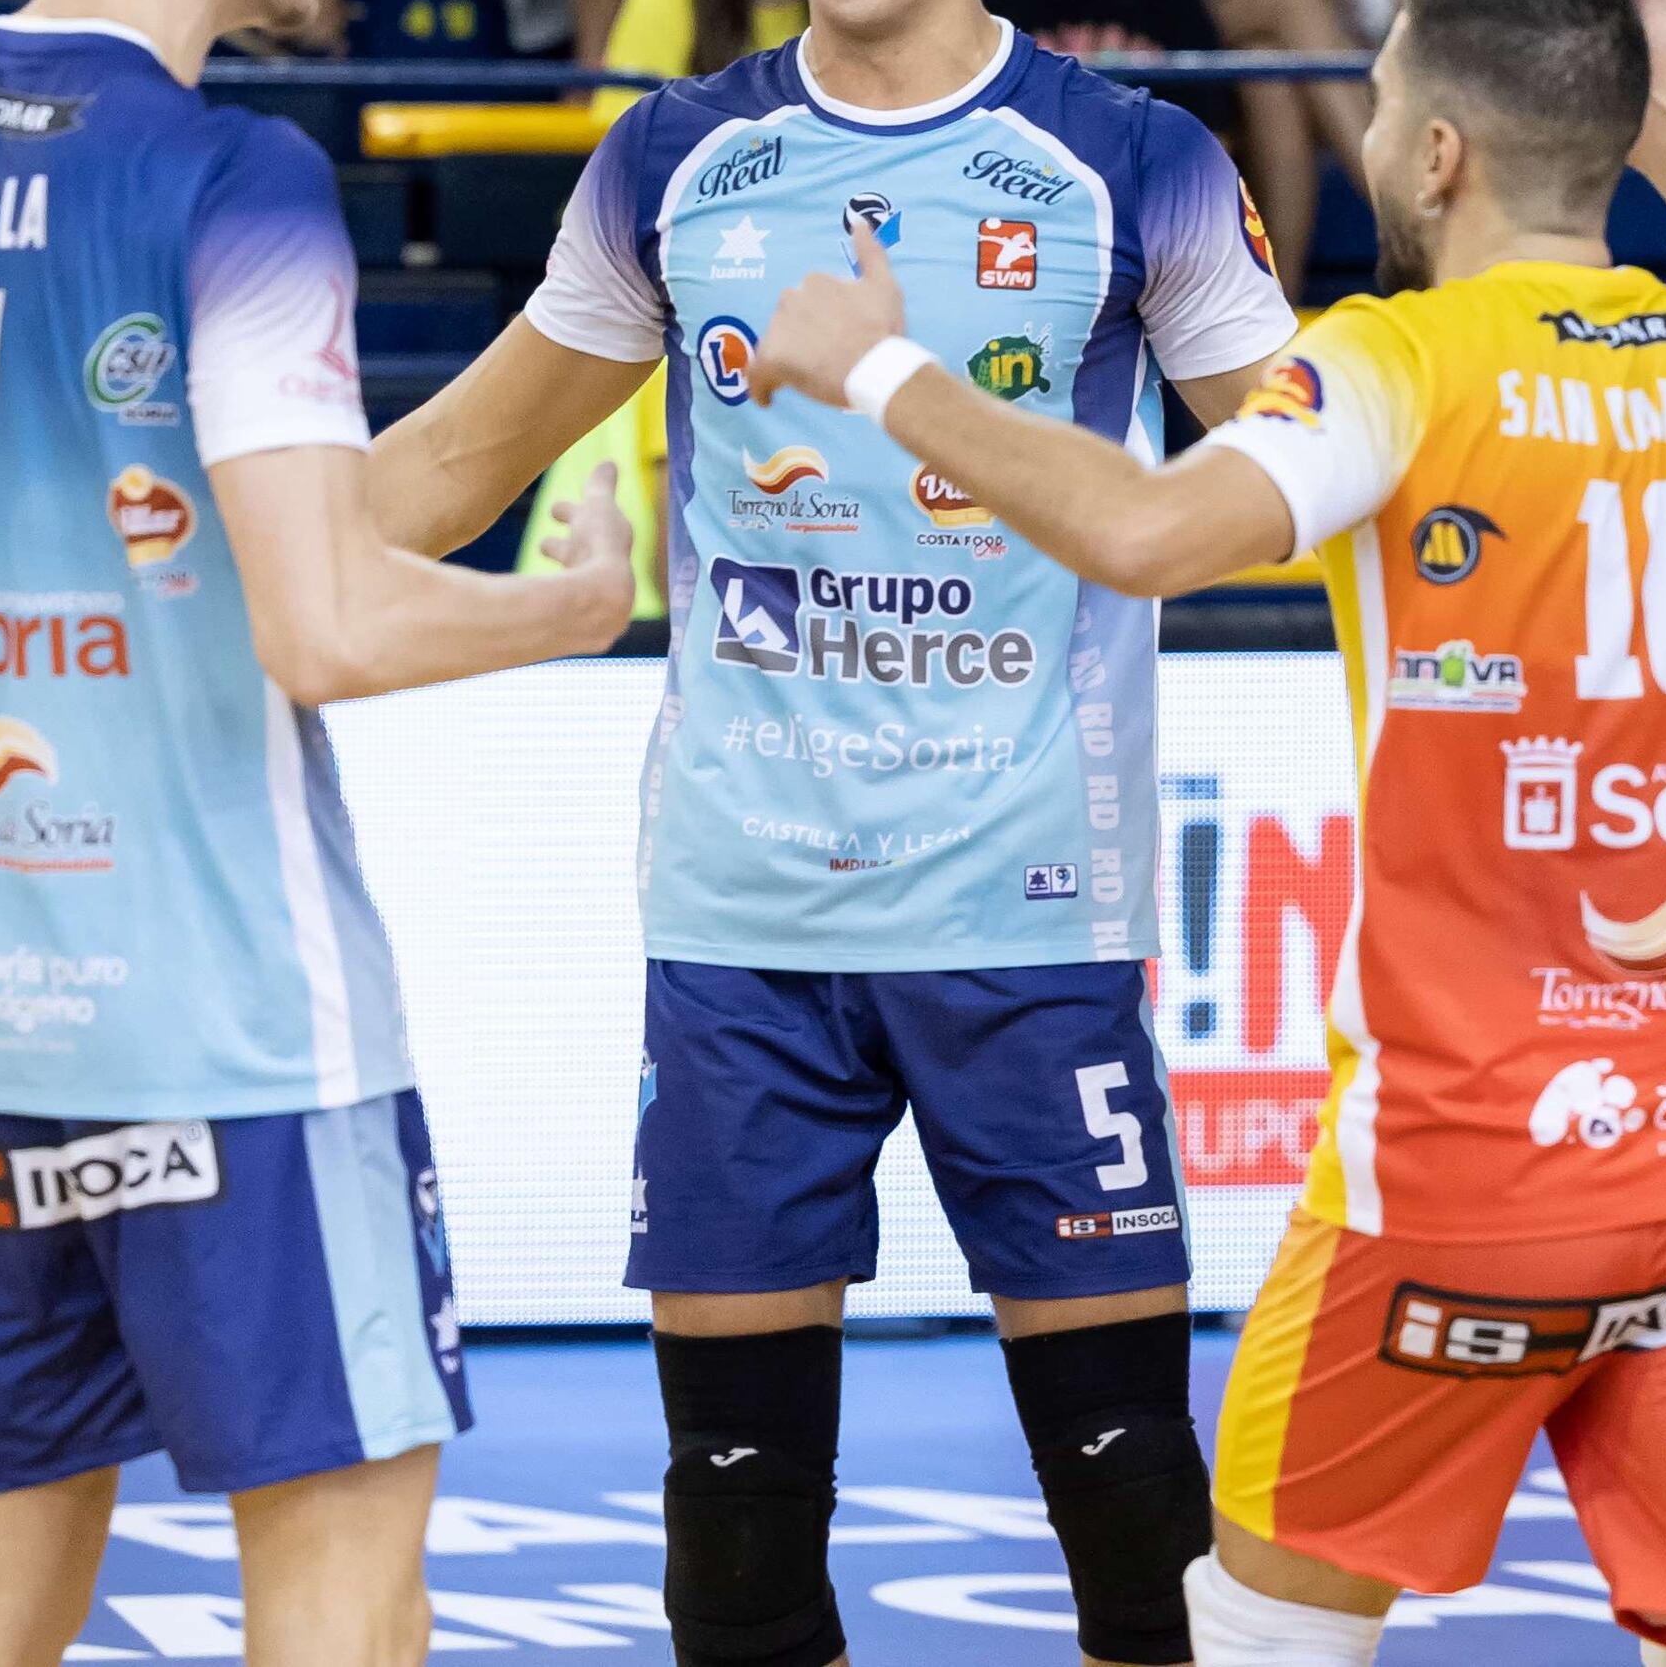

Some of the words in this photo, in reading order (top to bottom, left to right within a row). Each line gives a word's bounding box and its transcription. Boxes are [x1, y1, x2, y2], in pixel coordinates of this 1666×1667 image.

[696, 135, 787, 204] Real
[963, 150, 1075, 206] Real
[980, 269, 1032, 287] SVM
[989, 340, 1033, 386] in
[1497, 369, 1599, 447] SAN
[810, 490, 859, 519] Soria
[917, 534, 961, 546] COSTA
[810, 568, 972, 617] Grupo
[808, 619, 1035, 684] Herce
[722, 711, 1016, 779] #eligeSoria
[876, 832, 897, 858] Y
[1530, 967, 1655, 1022] Torrezno
[1075, 1061, 1148, 1191] 5
